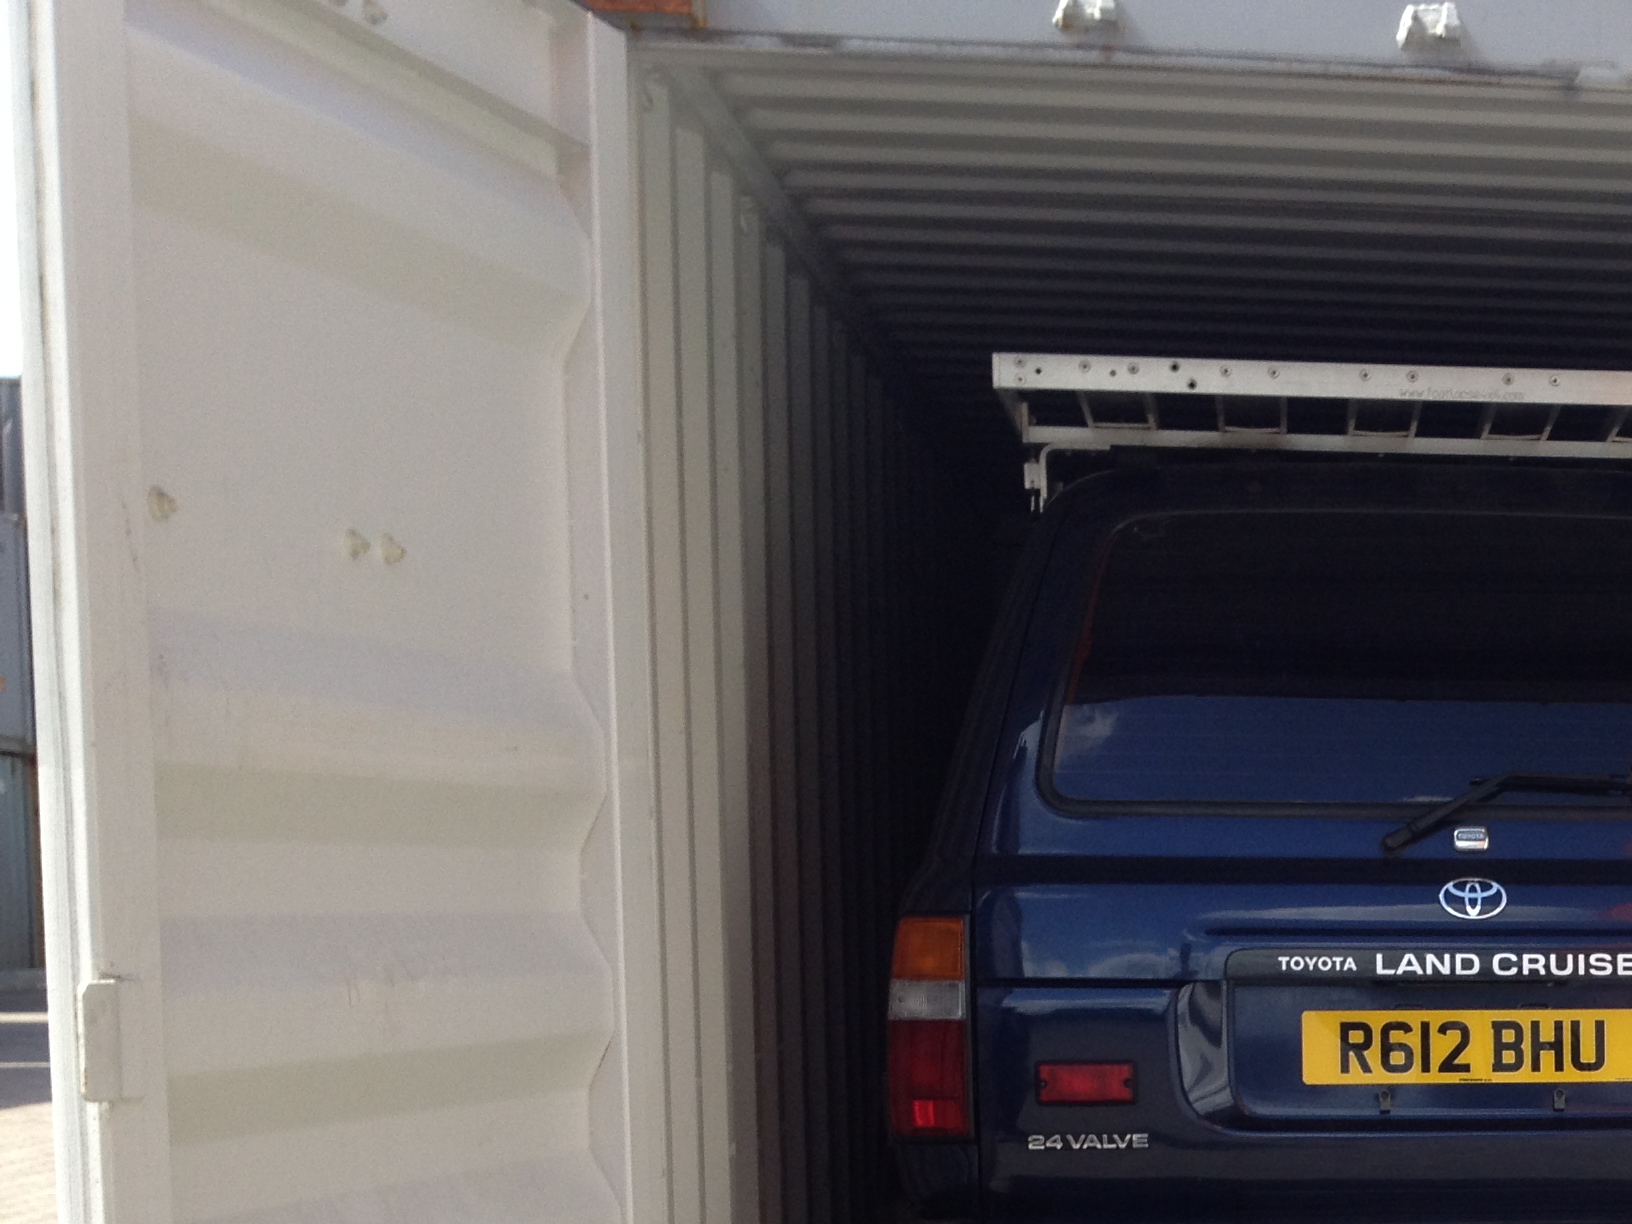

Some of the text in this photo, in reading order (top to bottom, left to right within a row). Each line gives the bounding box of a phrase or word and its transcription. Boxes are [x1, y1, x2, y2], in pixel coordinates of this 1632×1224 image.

[1277, 955, 1358, 972] TOYOTA
[1376, 953, 1481, 976] LAND
[1339, 1019, 1606, 1075] R612 BHU
[1027, 1132, 1150, 1150] 24 VALVE
